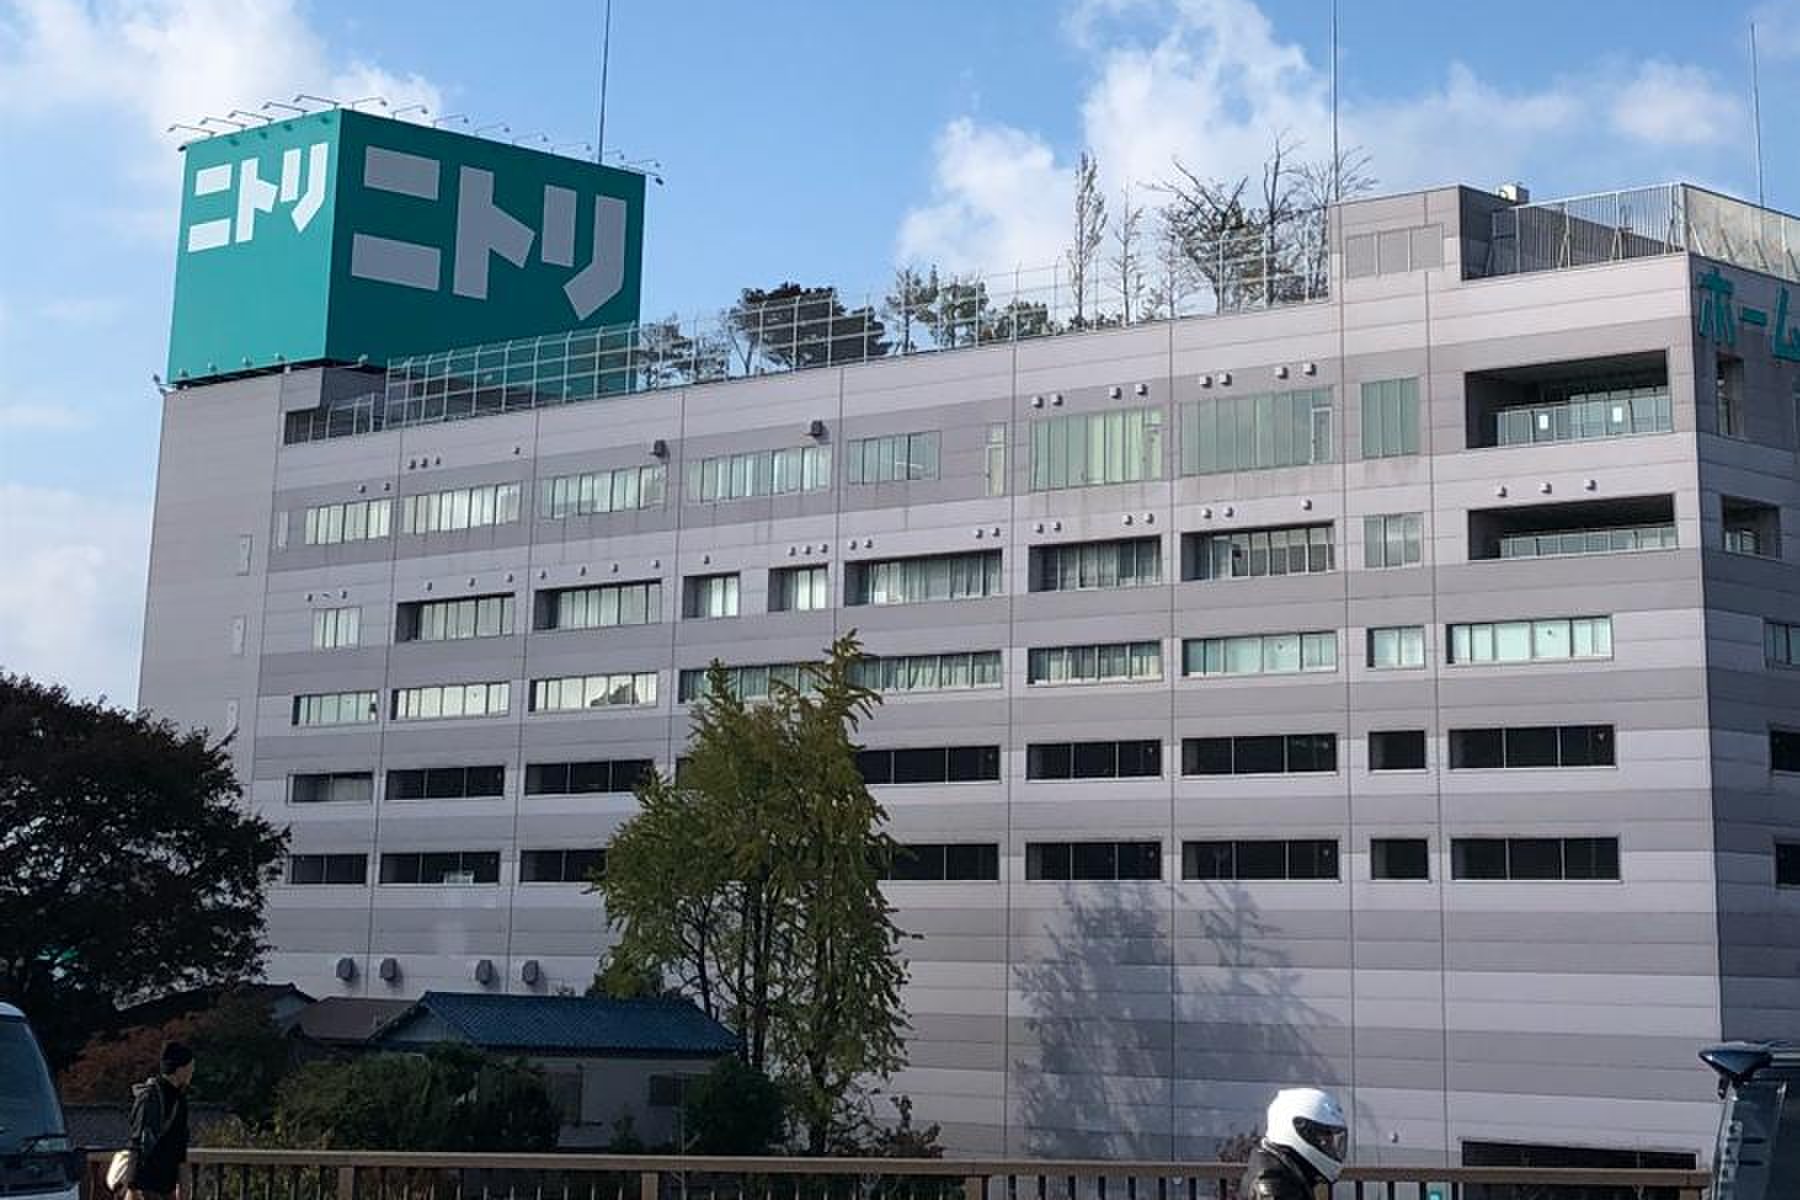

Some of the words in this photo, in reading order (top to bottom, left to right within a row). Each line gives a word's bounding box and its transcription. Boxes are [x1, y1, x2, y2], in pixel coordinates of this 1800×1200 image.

[187, 143, 328, 253] ニトリ
[351, 145, 627, 321] ニトリ
